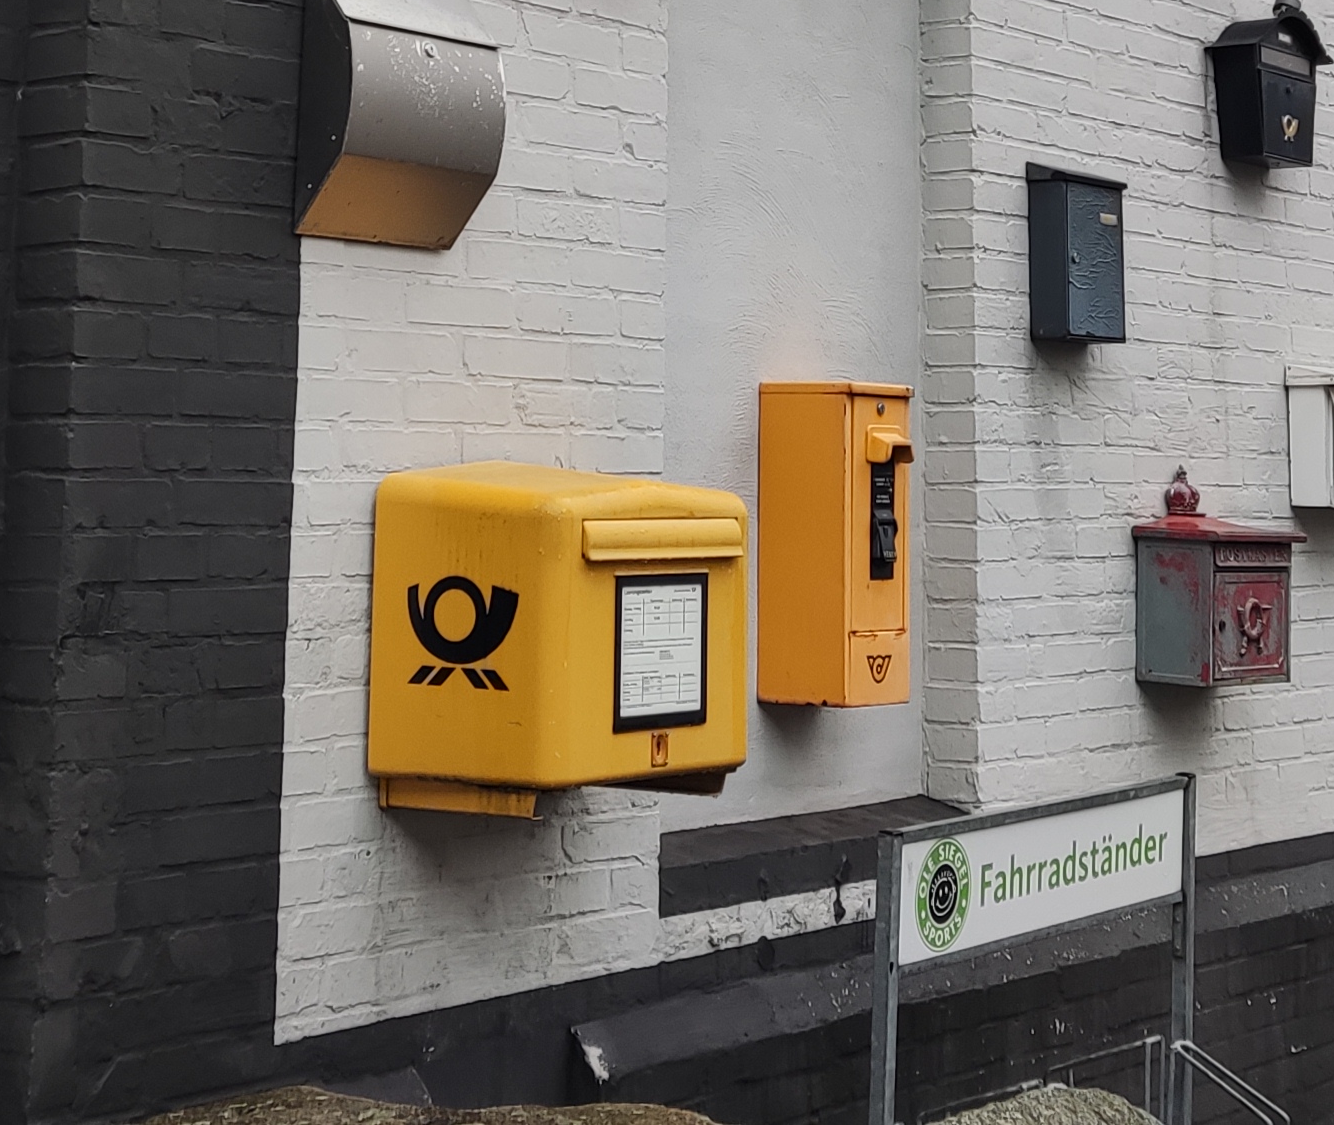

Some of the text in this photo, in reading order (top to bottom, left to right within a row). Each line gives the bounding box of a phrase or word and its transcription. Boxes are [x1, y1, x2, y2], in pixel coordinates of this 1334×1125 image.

[918, 844, 968, 899] OLE SIEGEL
[979, 824, 1168, 908] Fahrradständer
[923, 913, 962, 947] SPORTS
